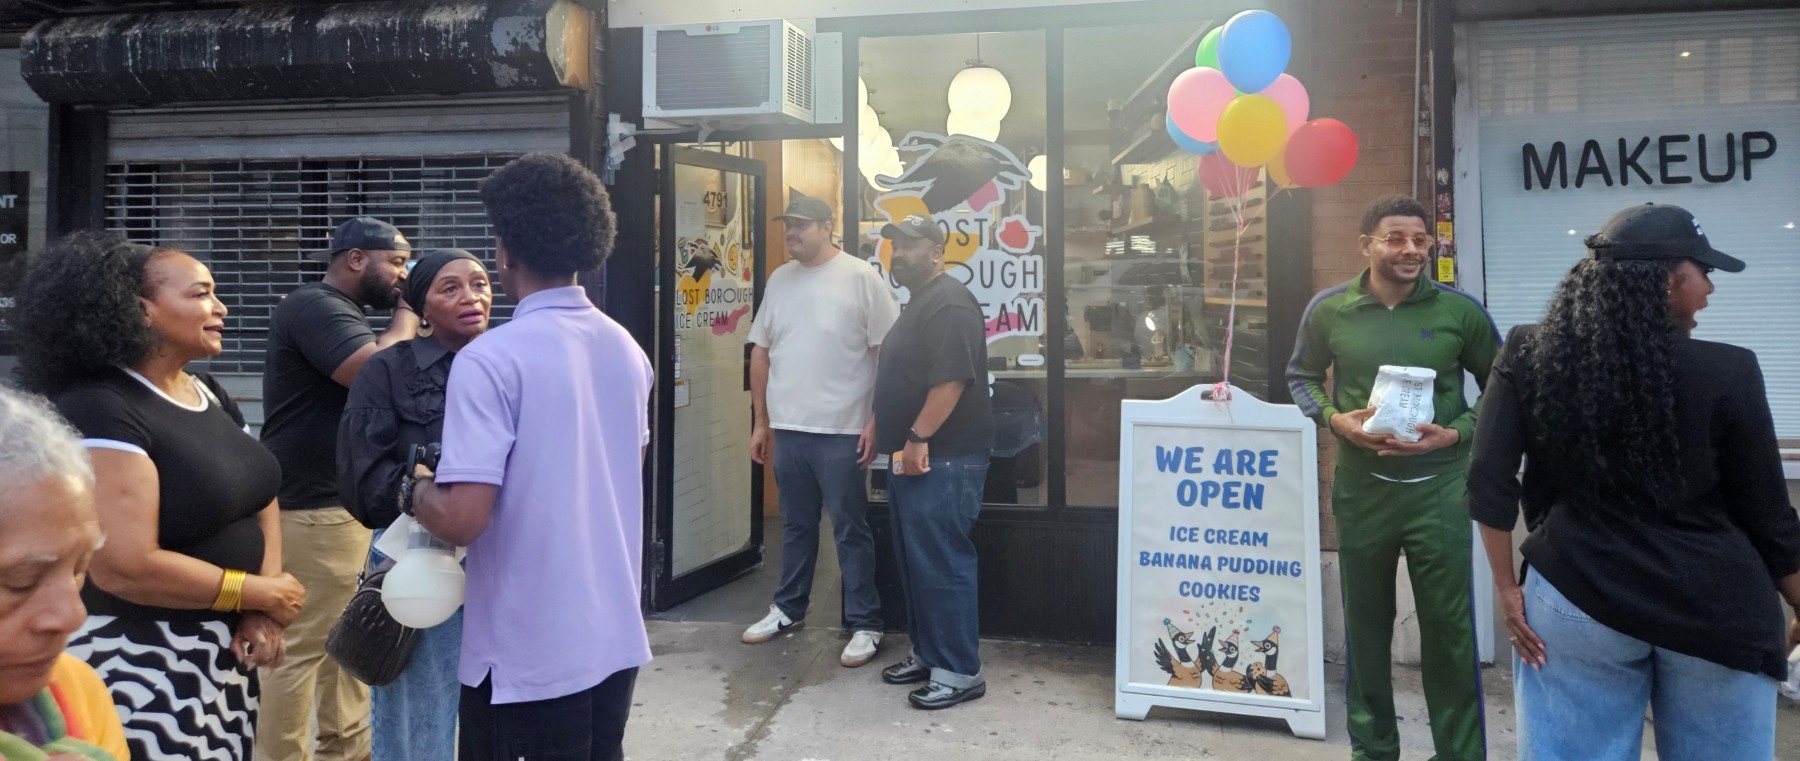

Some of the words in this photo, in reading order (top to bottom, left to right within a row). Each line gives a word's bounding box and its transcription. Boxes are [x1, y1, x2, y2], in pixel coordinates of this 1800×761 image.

[1522, 131, 1777, 190] MAKEUP
[703, 191, 728, 208] 4791
[936, 218, 988, 247] OST
[676, 288, 699, 305] LOST
[705, 288, 753, 304] BOROUGH
[675, 312, 691, 329] ICE
[697, 311, 728, 328] CREAM
[1414, 381, 1423, 391] ST
[1155, 445, 1204, 474] WE
[1213, 448, 1279, 477] ARE
[1176, 479, 1265, 510] OPEN
[1169, 526, 1199, 543] ICE
[1204, 528, 1268, 547] CREAM
[1139, 551, 1212, 571] BANANA
[1217, 556, 1302, 577] PUDDING
[1179, 581, 1261, 602] COOKIES
